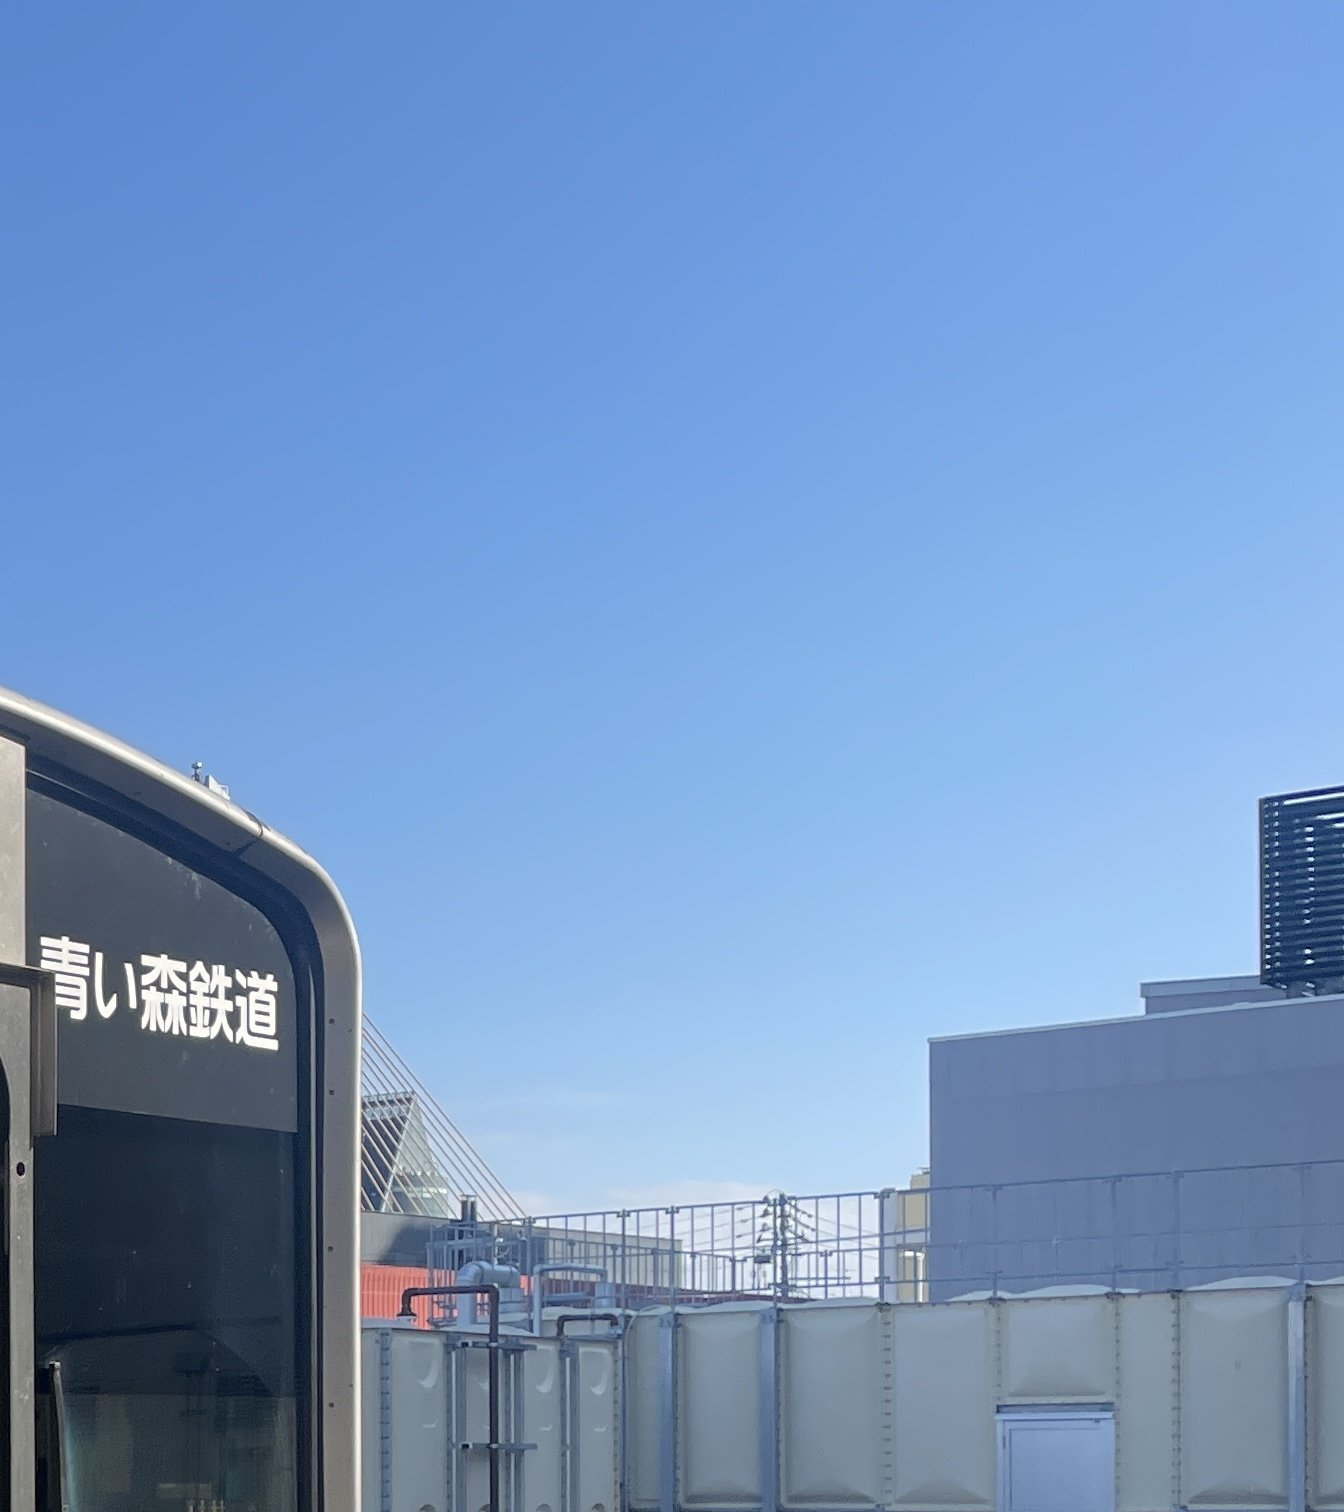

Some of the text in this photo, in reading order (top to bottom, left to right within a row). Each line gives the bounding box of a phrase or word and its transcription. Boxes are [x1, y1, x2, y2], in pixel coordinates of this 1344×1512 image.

[39, 935, 279, 1051] 青い森鉄道
